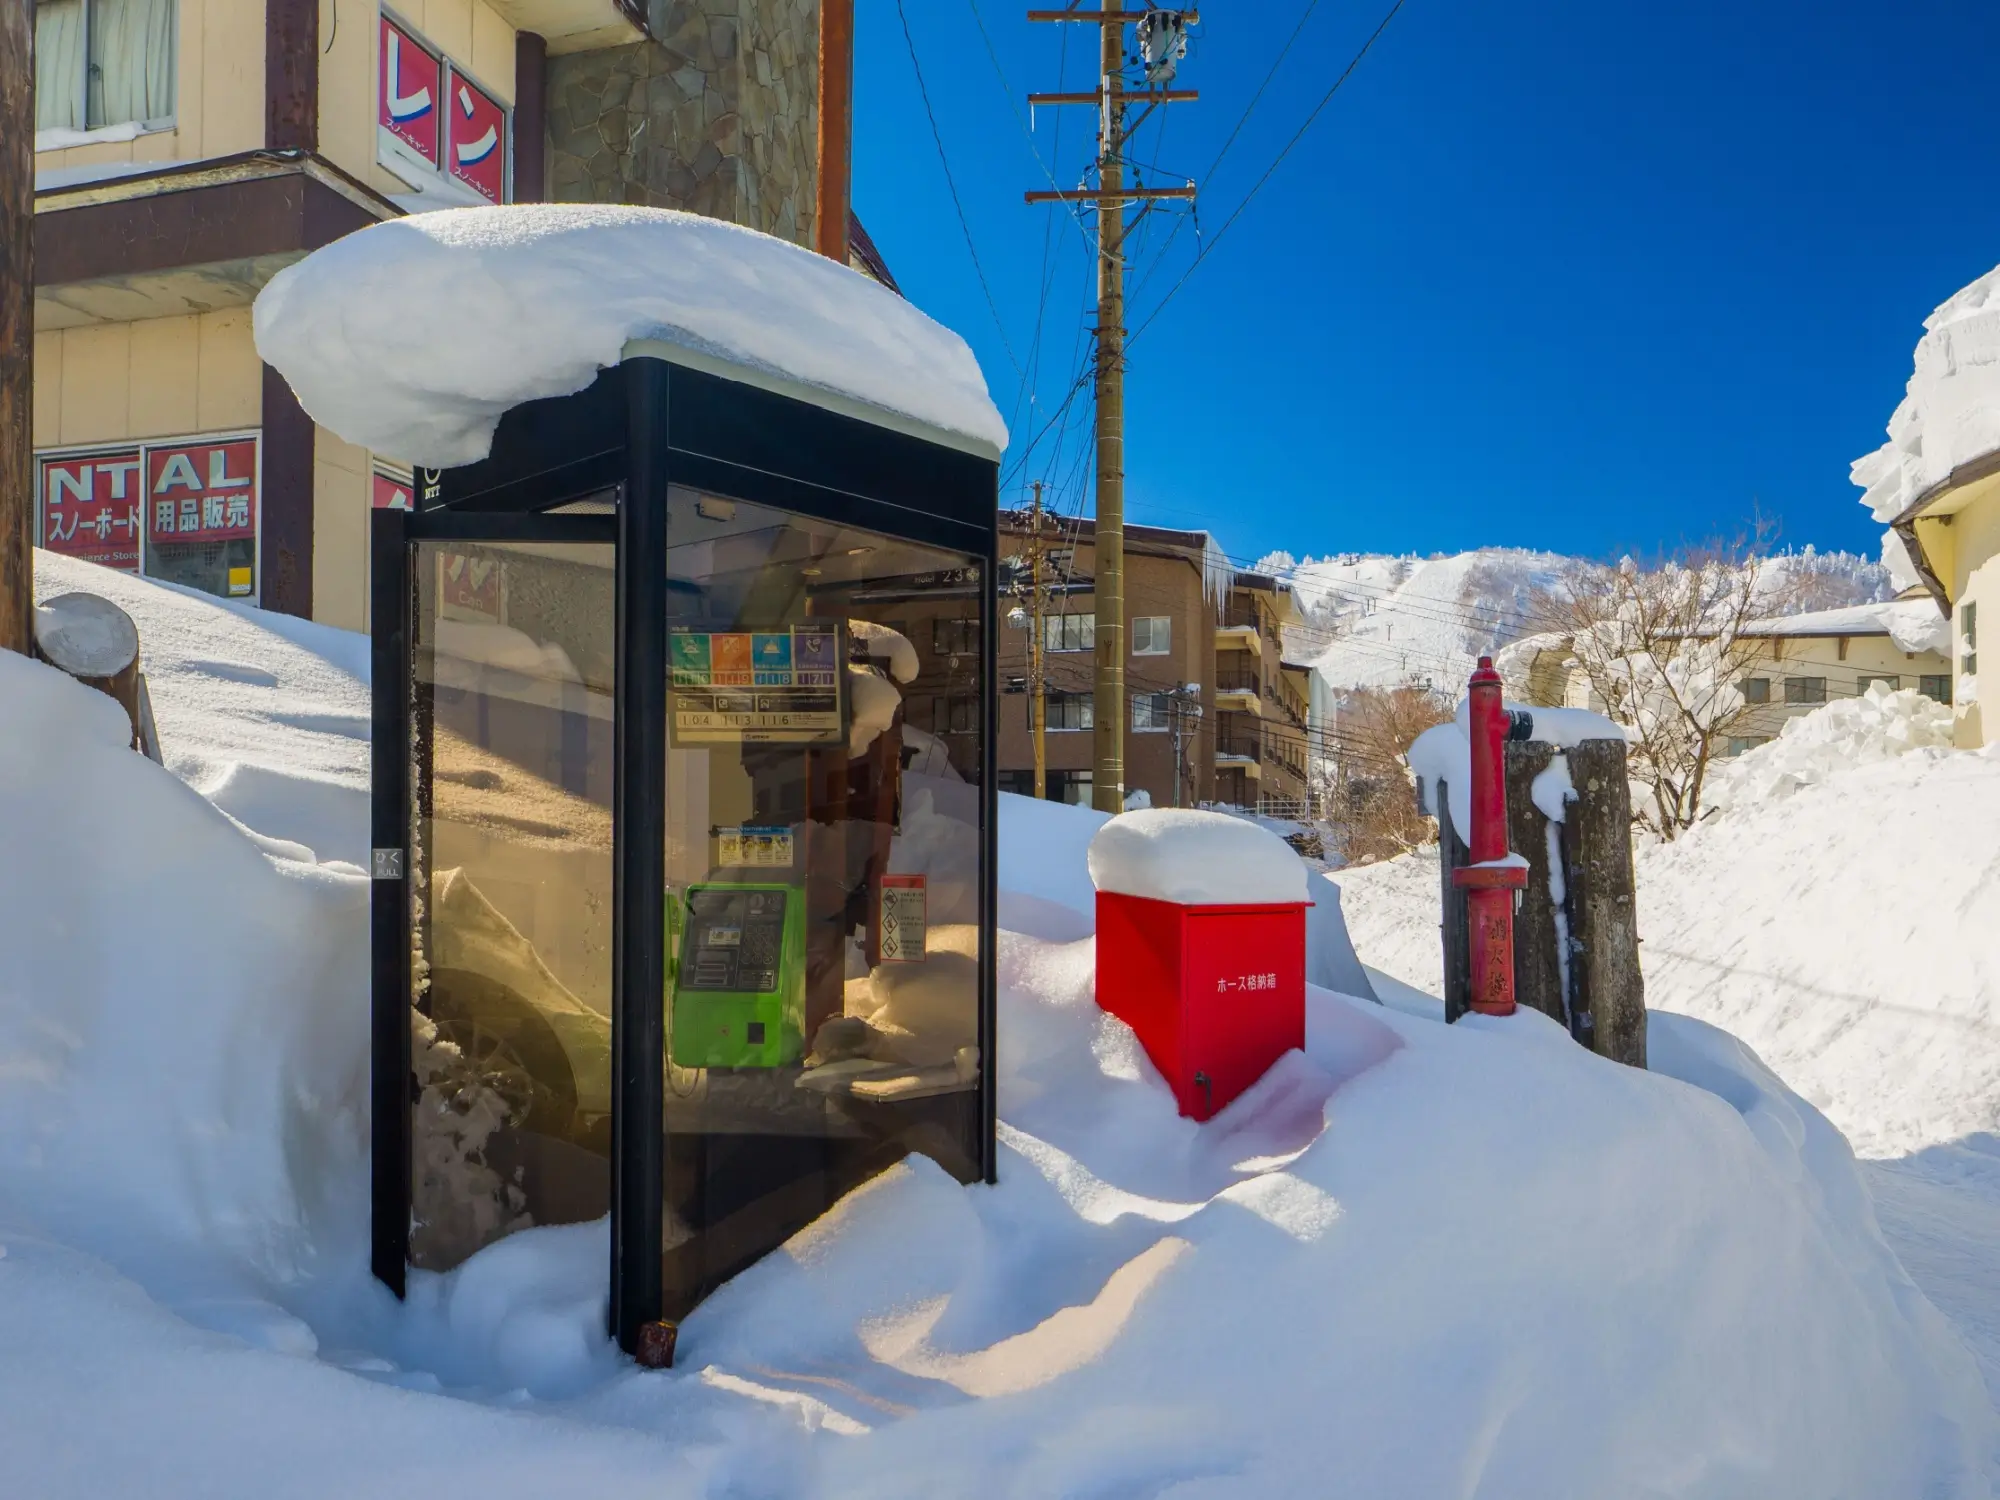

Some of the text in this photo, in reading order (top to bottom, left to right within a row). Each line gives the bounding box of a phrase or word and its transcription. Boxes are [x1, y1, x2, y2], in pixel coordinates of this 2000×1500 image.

[424, 485, 441, 500] NTT
[762, 715, 790, 725] 116
[375, 851, 400, 864] ひく
[376, 867, 399, 877] PULL
[1217, 972, 1277, 993] ホース格納箱
